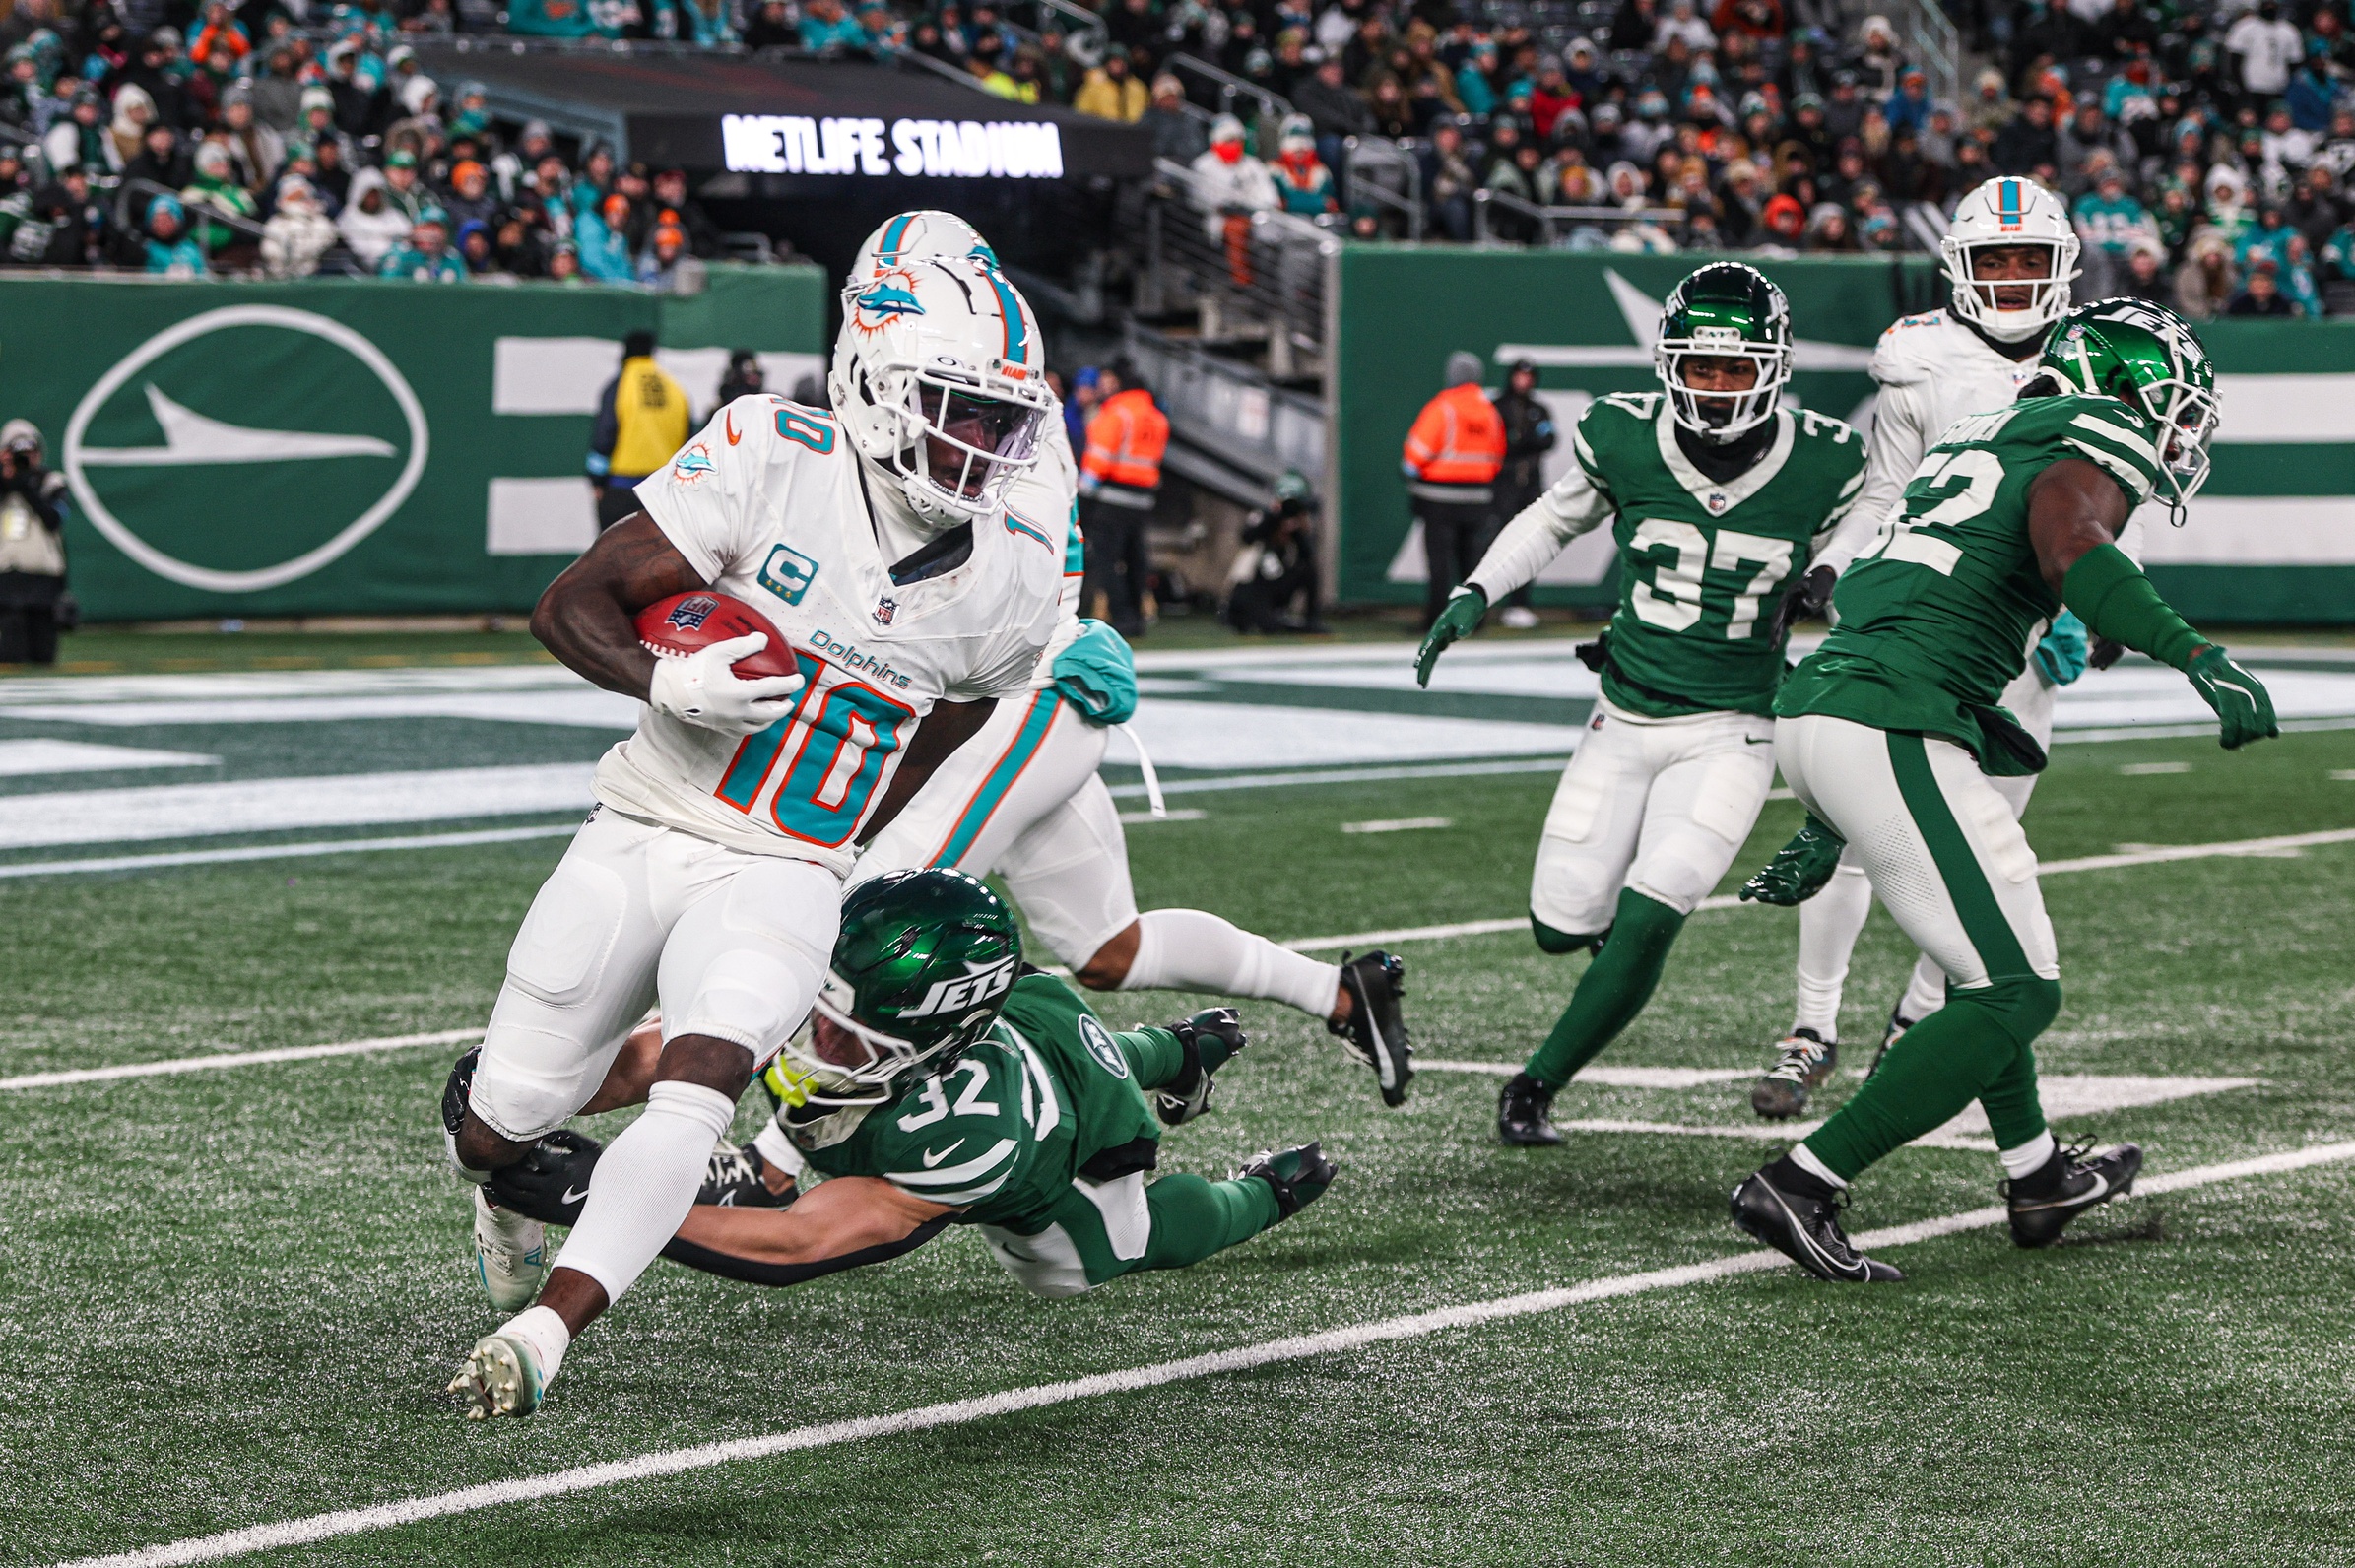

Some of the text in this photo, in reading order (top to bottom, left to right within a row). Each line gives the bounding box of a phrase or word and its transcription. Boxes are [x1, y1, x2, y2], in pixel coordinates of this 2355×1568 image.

[721, 113, 1065, 179] METLIFE STADIUM
[766, 549, 814, 592] C
[1628, 516, 1795, 640] 37
[809, 629, 912, 689] Dolphins
[713, 646, 917, 849] 10
[896, 953, 1016, 1018] JETS
[896, 1058, 1001, 1133] 32
